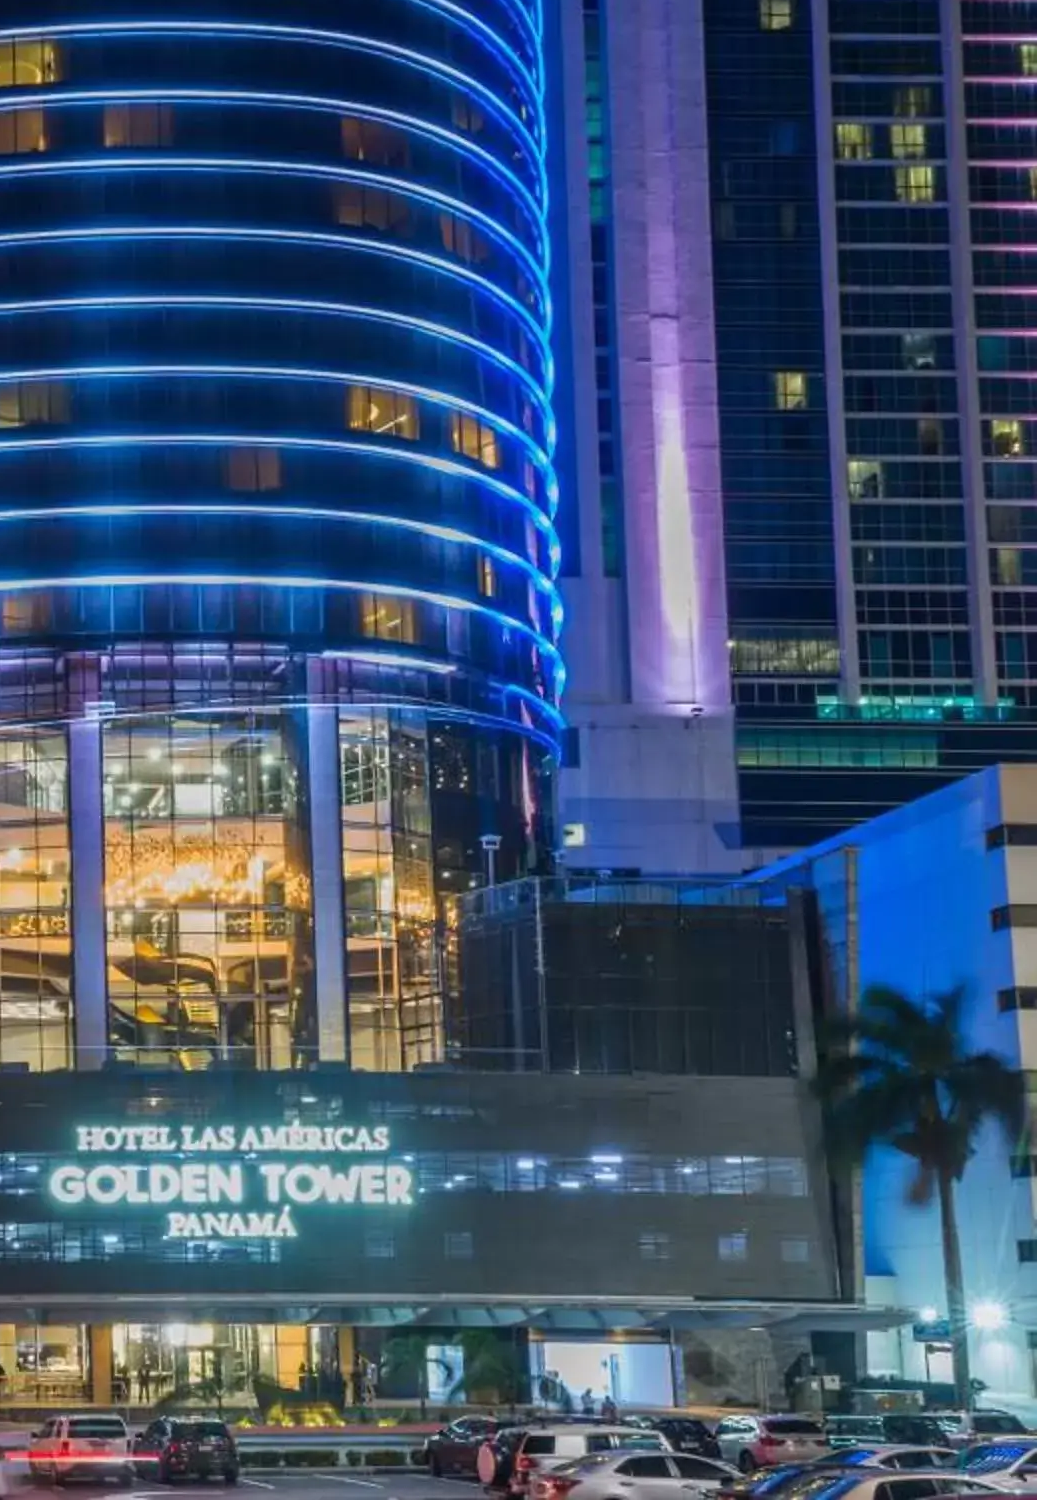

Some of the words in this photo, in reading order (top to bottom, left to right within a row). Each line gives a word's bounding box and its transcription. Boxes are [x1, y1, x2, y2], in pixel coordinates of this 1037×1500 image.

[77, 1126, 176, 1151] HOTEL
[181, 1126, 235, 1151] LAS
[240, 1120, 390, 1151] AMÉRICAS
[50, 1164, 243, 1204] GOLDEN
[261, 1164, 413, 1205] TOWER
[167, 1206, 298, 1238] PANAMÁ
